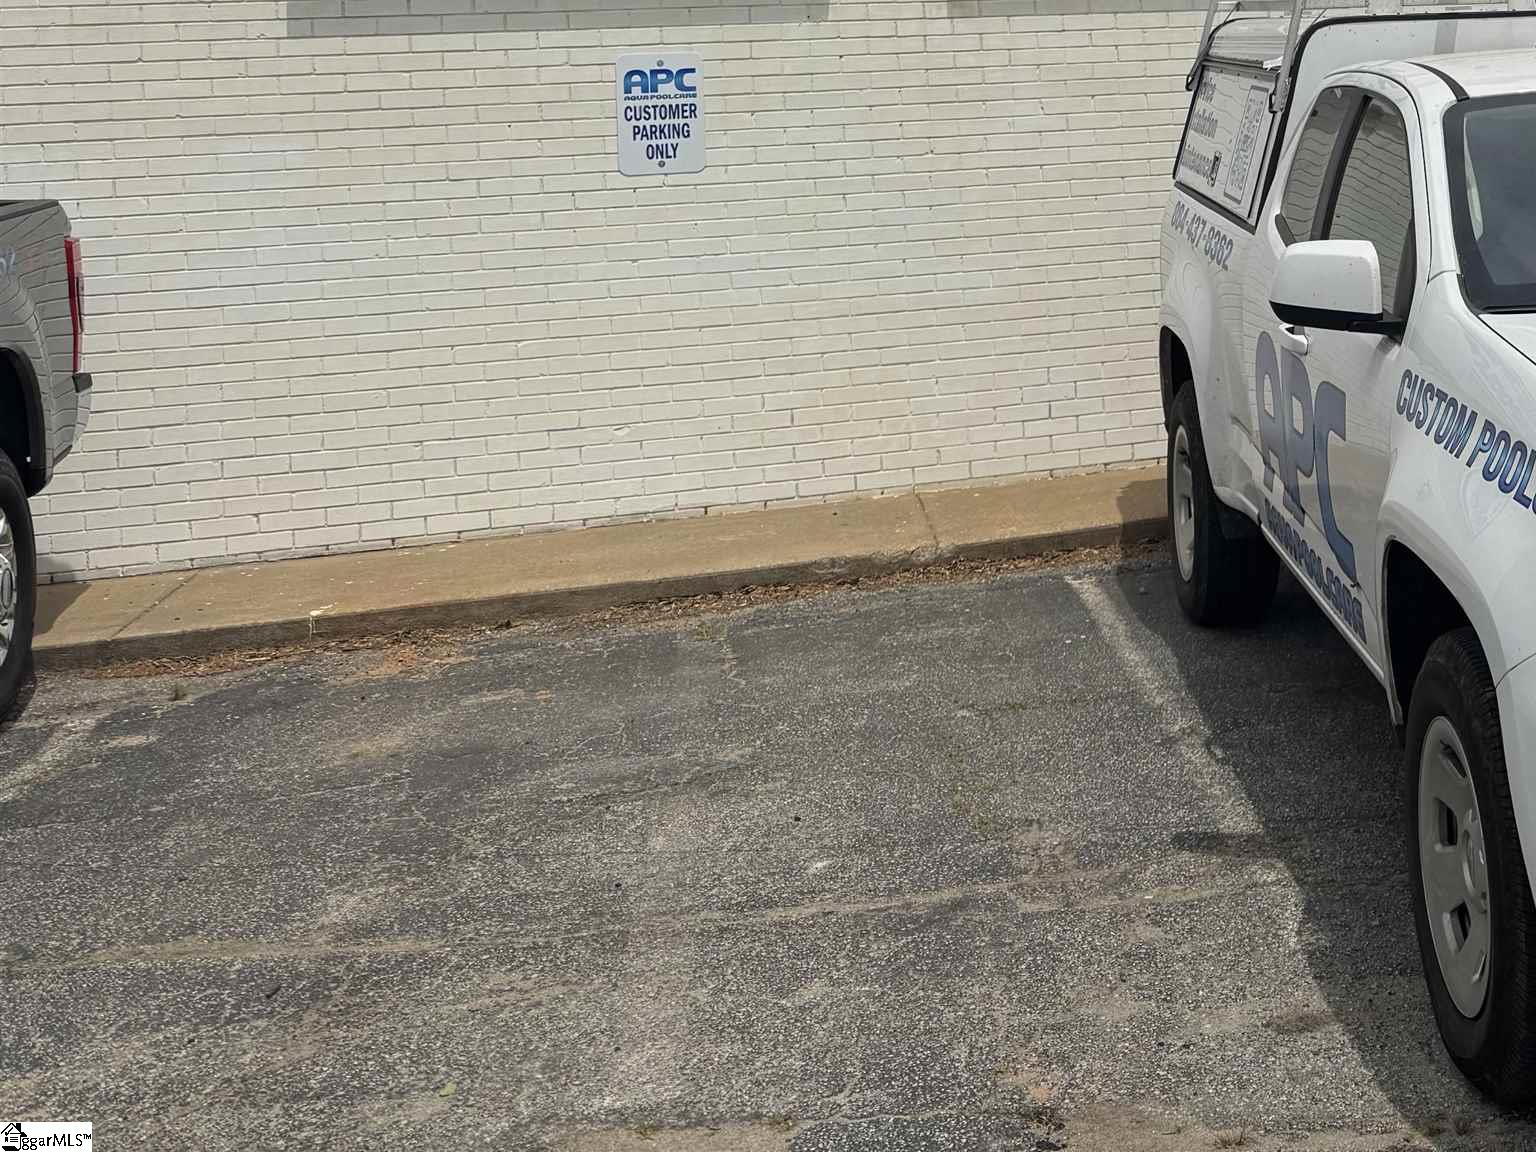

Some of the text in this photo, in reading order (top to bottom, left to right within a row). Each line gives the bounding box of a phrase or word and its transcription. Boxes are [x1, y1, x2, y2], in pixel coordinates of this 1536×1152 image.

[623, 68, 697, 95] APC
[624, 103, 698, 122] CUSTOMER
[632, 123, 691, 141] PARKING
[646, 142, 679, 160] ONLY
[1396, 369, 1479, 459] CUSTOM
[1256, 330, 1357, 586] APC
